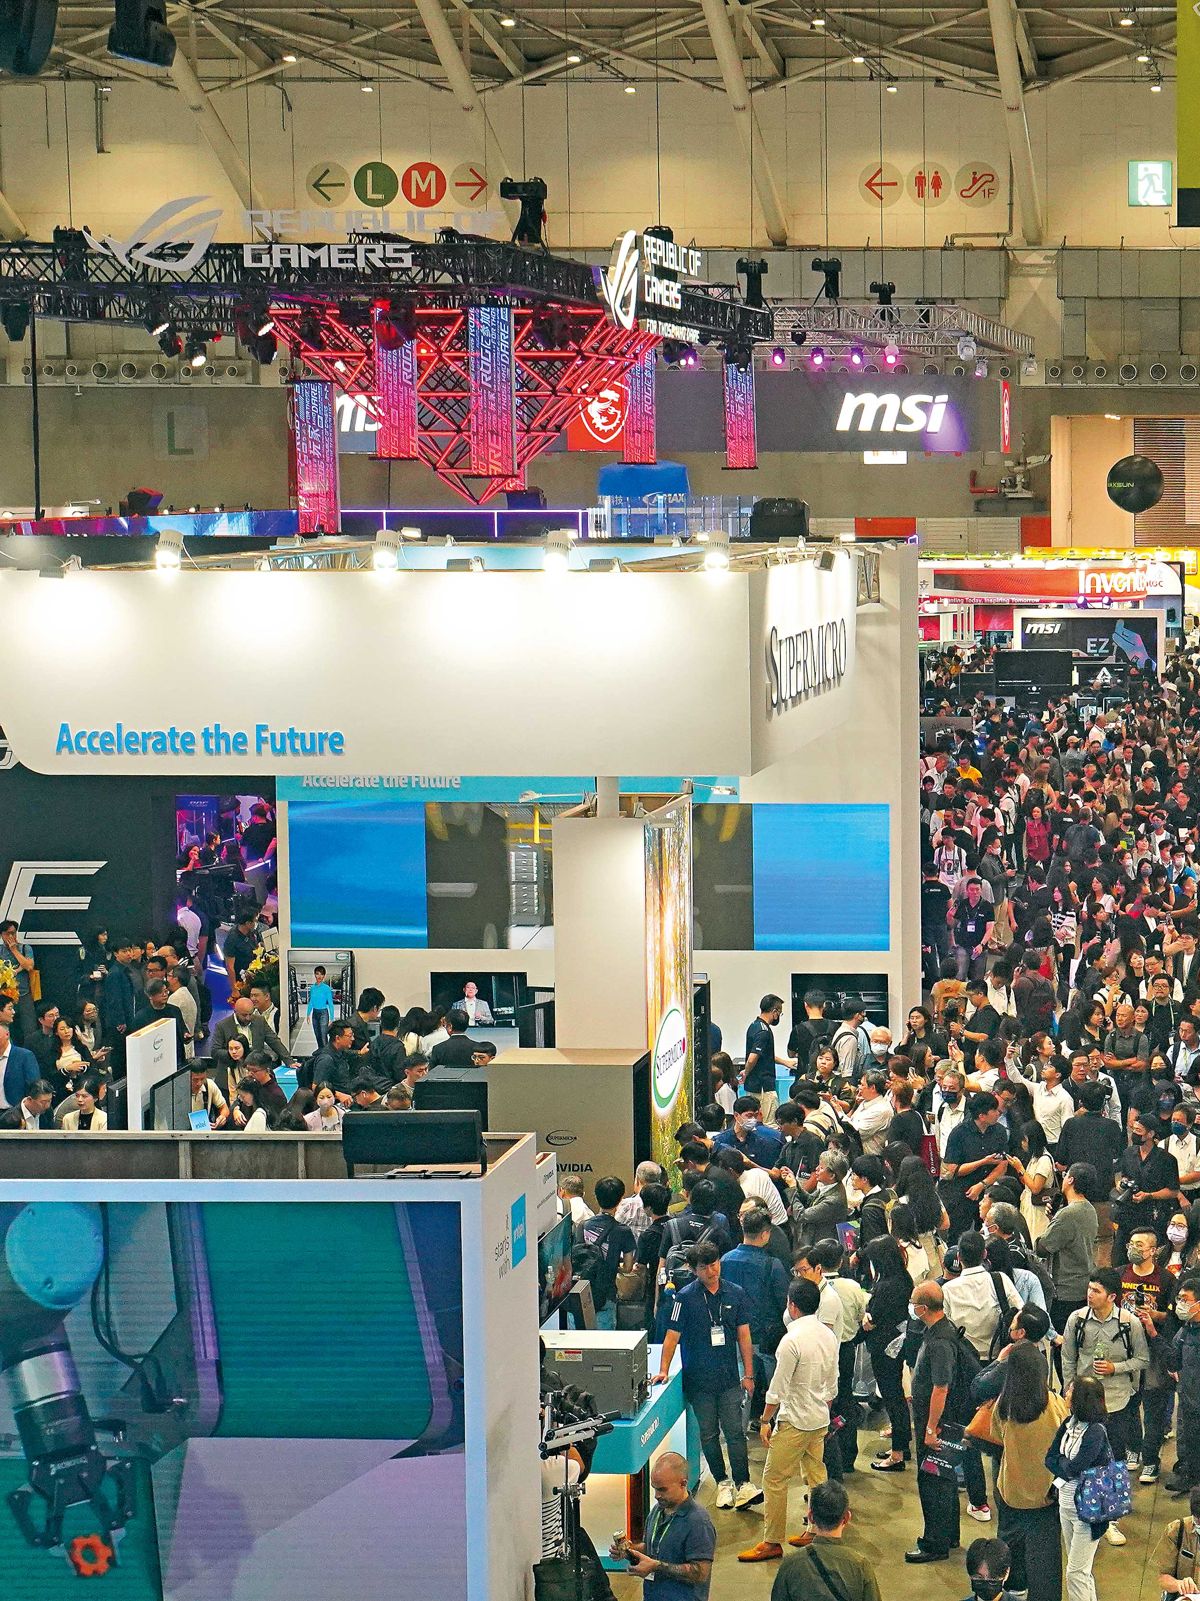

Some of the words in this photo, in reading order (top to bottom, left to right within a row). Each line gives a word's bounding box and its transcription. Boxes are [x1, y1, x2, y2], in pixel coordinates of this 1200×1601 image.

[366, 169, 385, 200] L
[410, 170, 436, 200] M
[981, 188, 995, 199] 1F
[243, 244, 413, 268] GAMERS
[643, 233, 688, 274] REPUBLIC
[688, 249, 702, 276] OF
[644, 274, 682, 310] GAMERS
[499, 322, 510, 365] DARE
[336, 394, 385, 432] ms
[836, 391, 949, 433] msi
[1025, 623, 1062, 634] msi
[1086, 637, 1110, 654] EZ
[769, 617, 848, 709] SUPERMICRO
[55, 722, 196, 754] Accelerate
[200, 723, 248, 754] the
[255, 724, 346, 754] Future
[302, 775, 380, 789] Accelerate
[383, 775, 408, 789] the
[411, 775, 461, 789] Future
